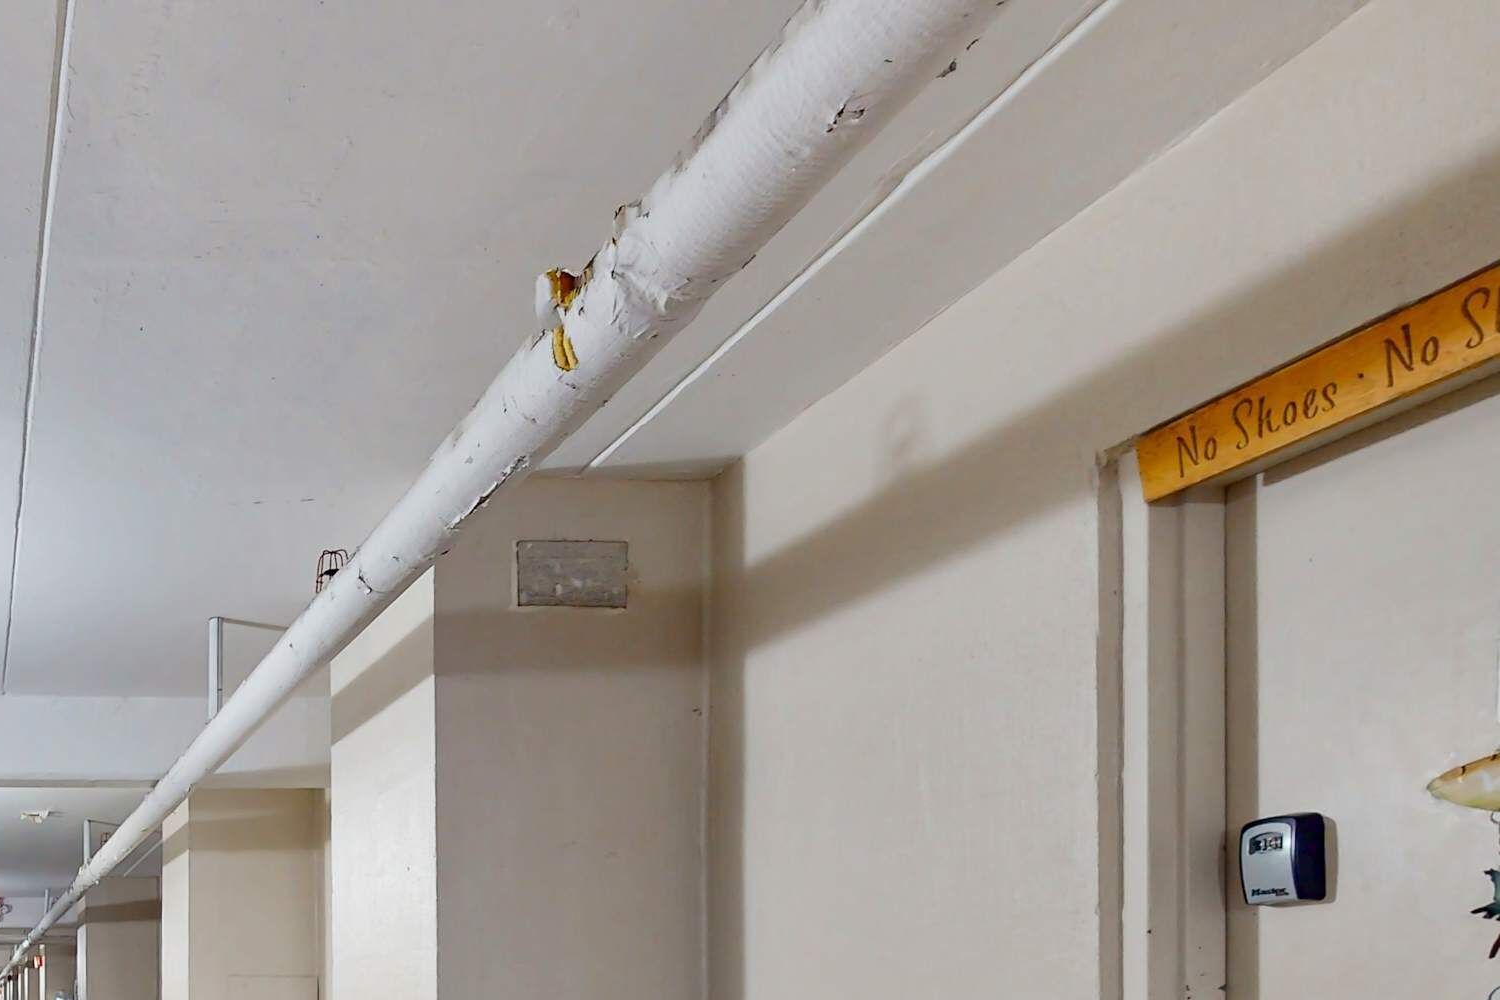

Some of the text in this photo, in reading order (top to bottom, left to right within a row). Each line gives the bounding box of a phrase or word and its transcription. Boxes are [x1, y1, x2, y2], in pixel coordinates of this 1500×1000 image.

[1176, 287, 1500, 478] No Shoes No S
